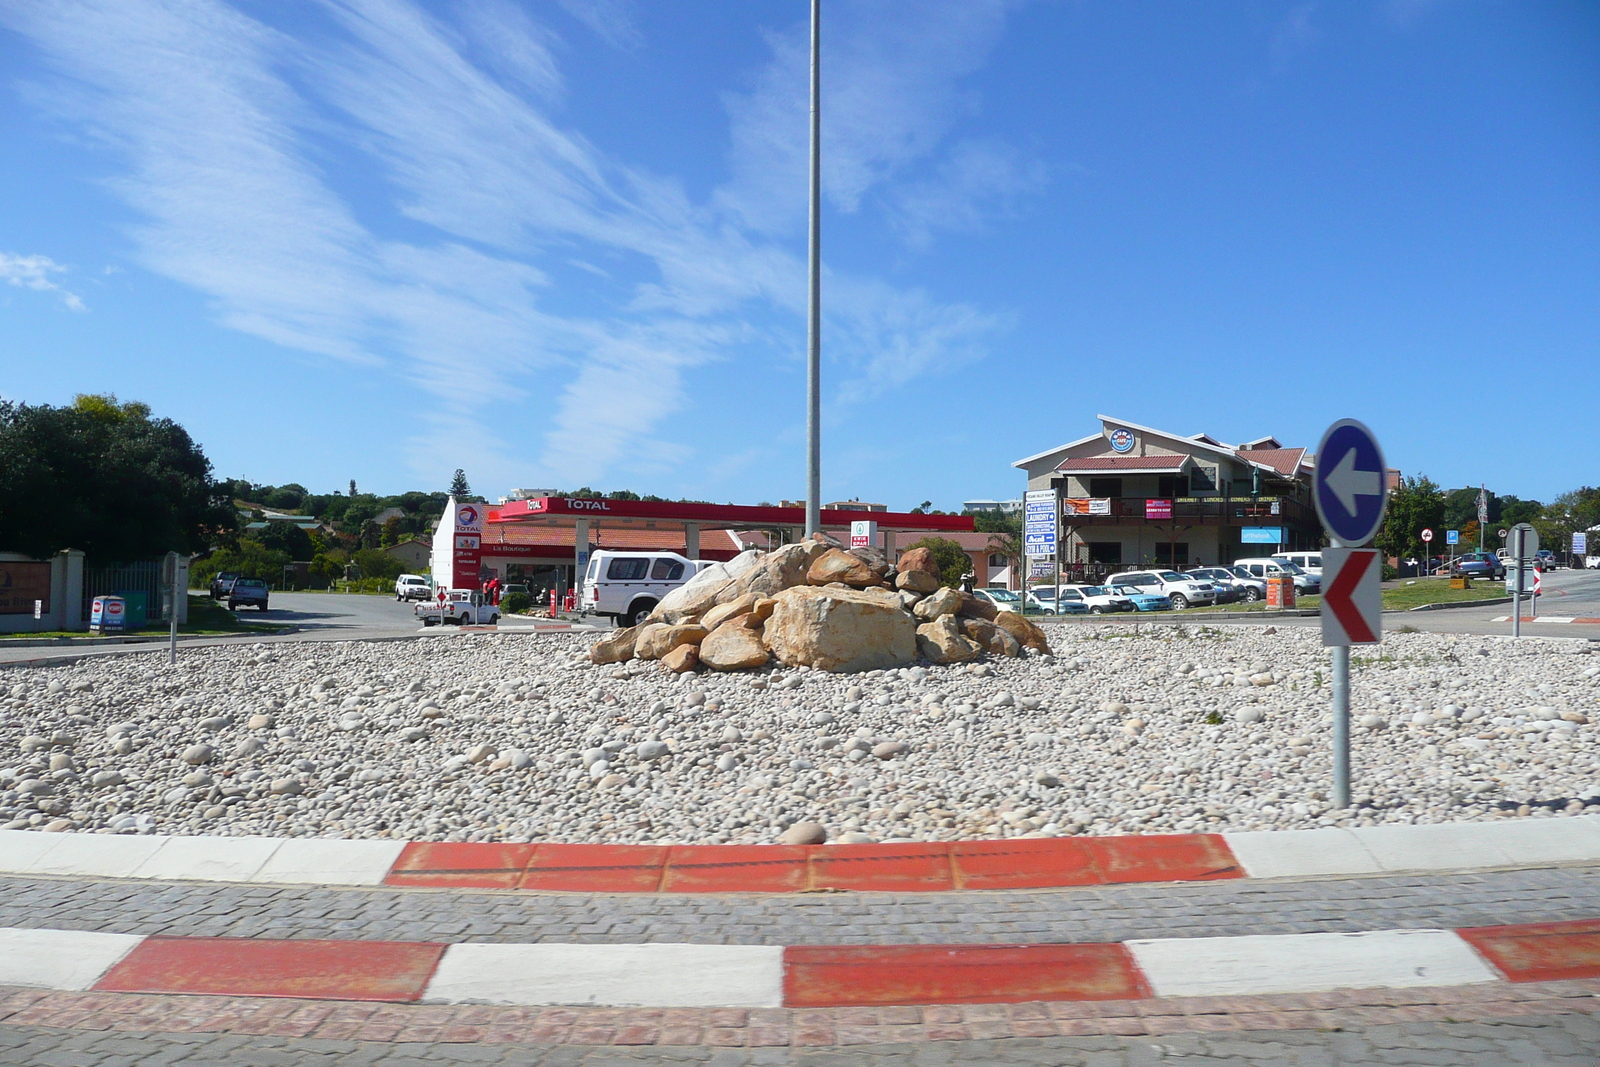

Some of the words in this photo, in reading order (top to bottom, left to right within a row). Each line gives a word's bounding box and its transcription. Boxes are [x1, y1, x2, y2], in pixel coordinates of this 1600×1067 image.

[527, 500, 542, 510] TOTAL
[564, 498, 611, 510] TOTAL
[1027, 513, 1049, 521] LAUNDRY
[1040, 544, 1050, 553] POOL
